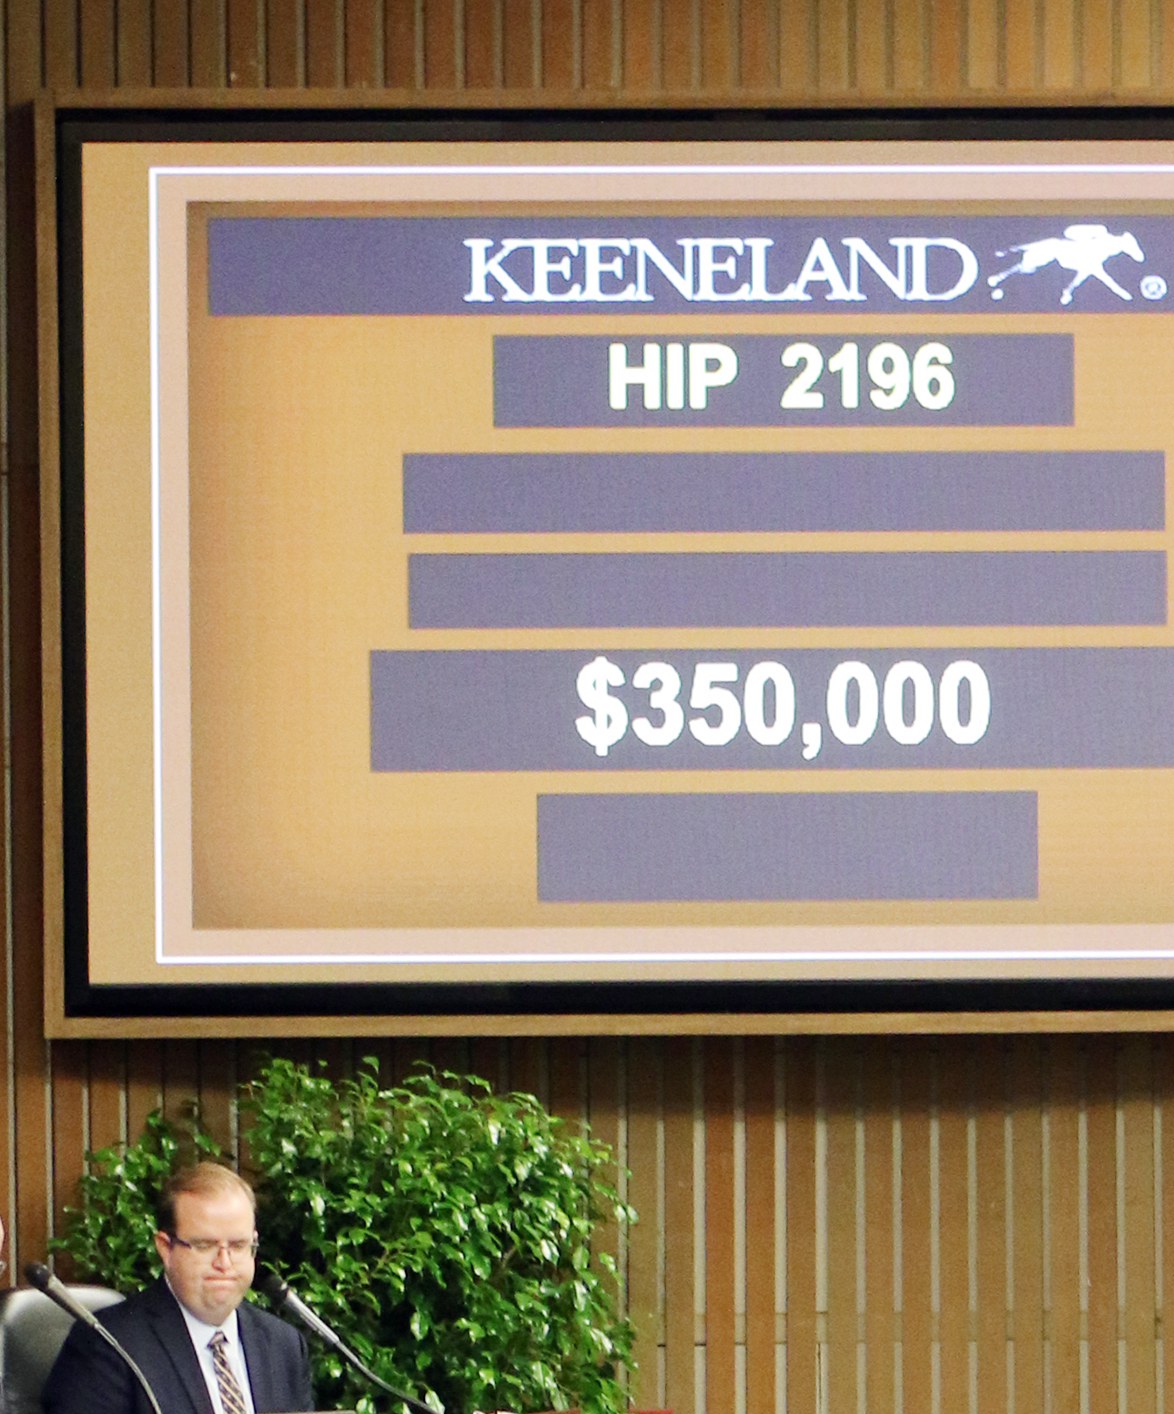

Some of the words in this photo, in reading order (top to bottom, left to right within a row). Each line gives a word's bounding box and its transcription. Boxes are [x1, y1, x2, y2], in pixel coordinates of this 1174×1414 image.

[462, 236, 979, 303] KEENELAND
[608, 342, 738, 411] HIP
[780, 341, 956, 411] 2196
[574, 655, 992, 761] $350,000
